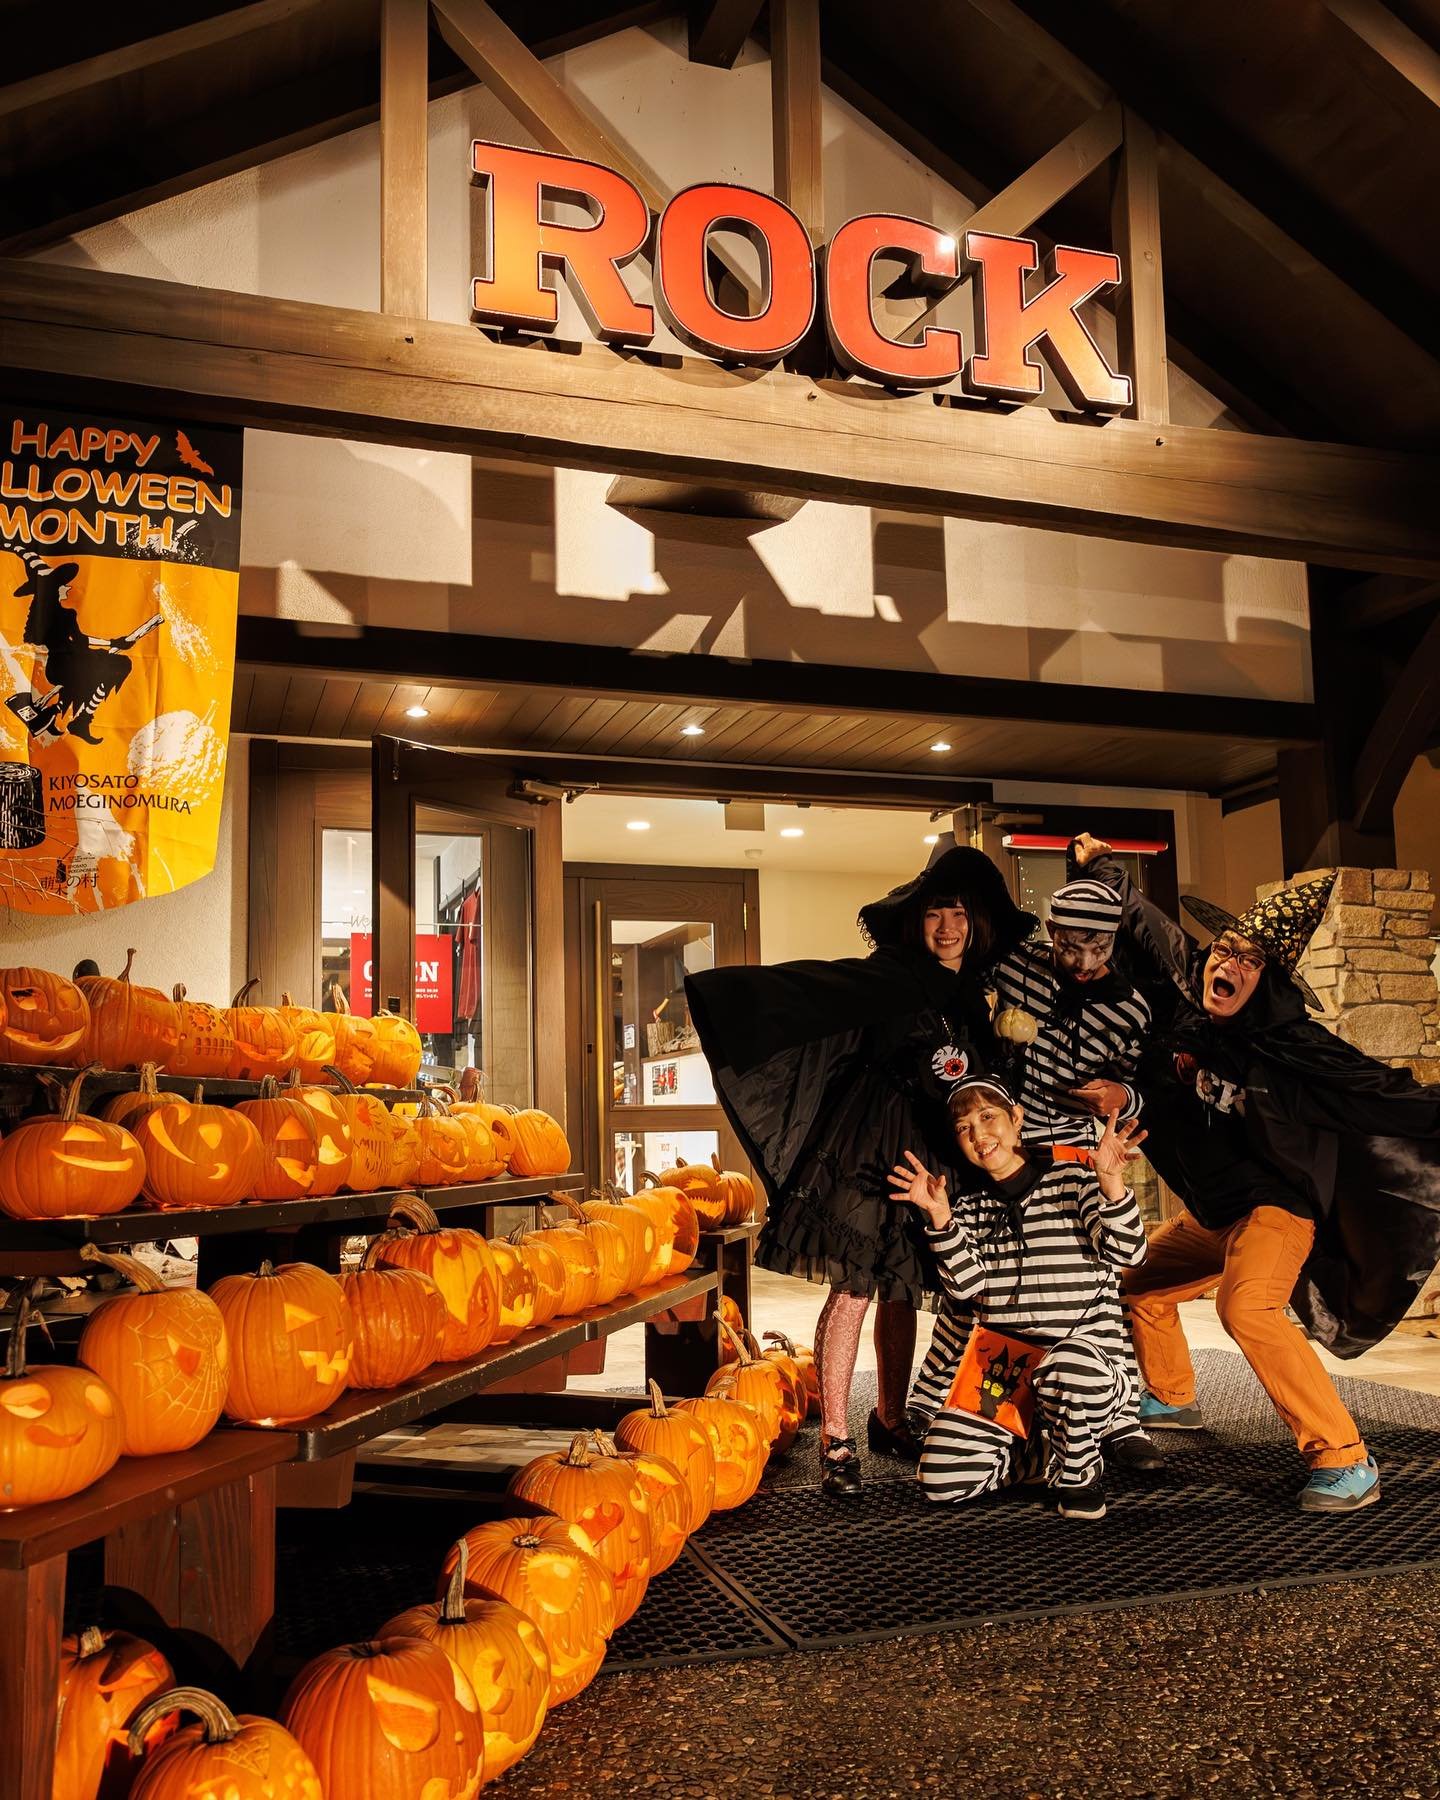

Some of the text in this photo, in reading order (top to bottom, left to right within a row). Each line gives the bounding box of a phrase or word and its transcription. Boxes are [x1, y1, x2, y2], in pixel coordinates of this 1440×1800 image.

[470, 139, 1134, 415] ROCK
[11, 419, 160, 467] HAPPY
[0, 460, 232, 518] LLOWEEN
[0, 503, 174, 549] MONTH
[49, 774, 139, 790] KIYOSATO
[49, 794, 191, 814] MOEGINOMURA
